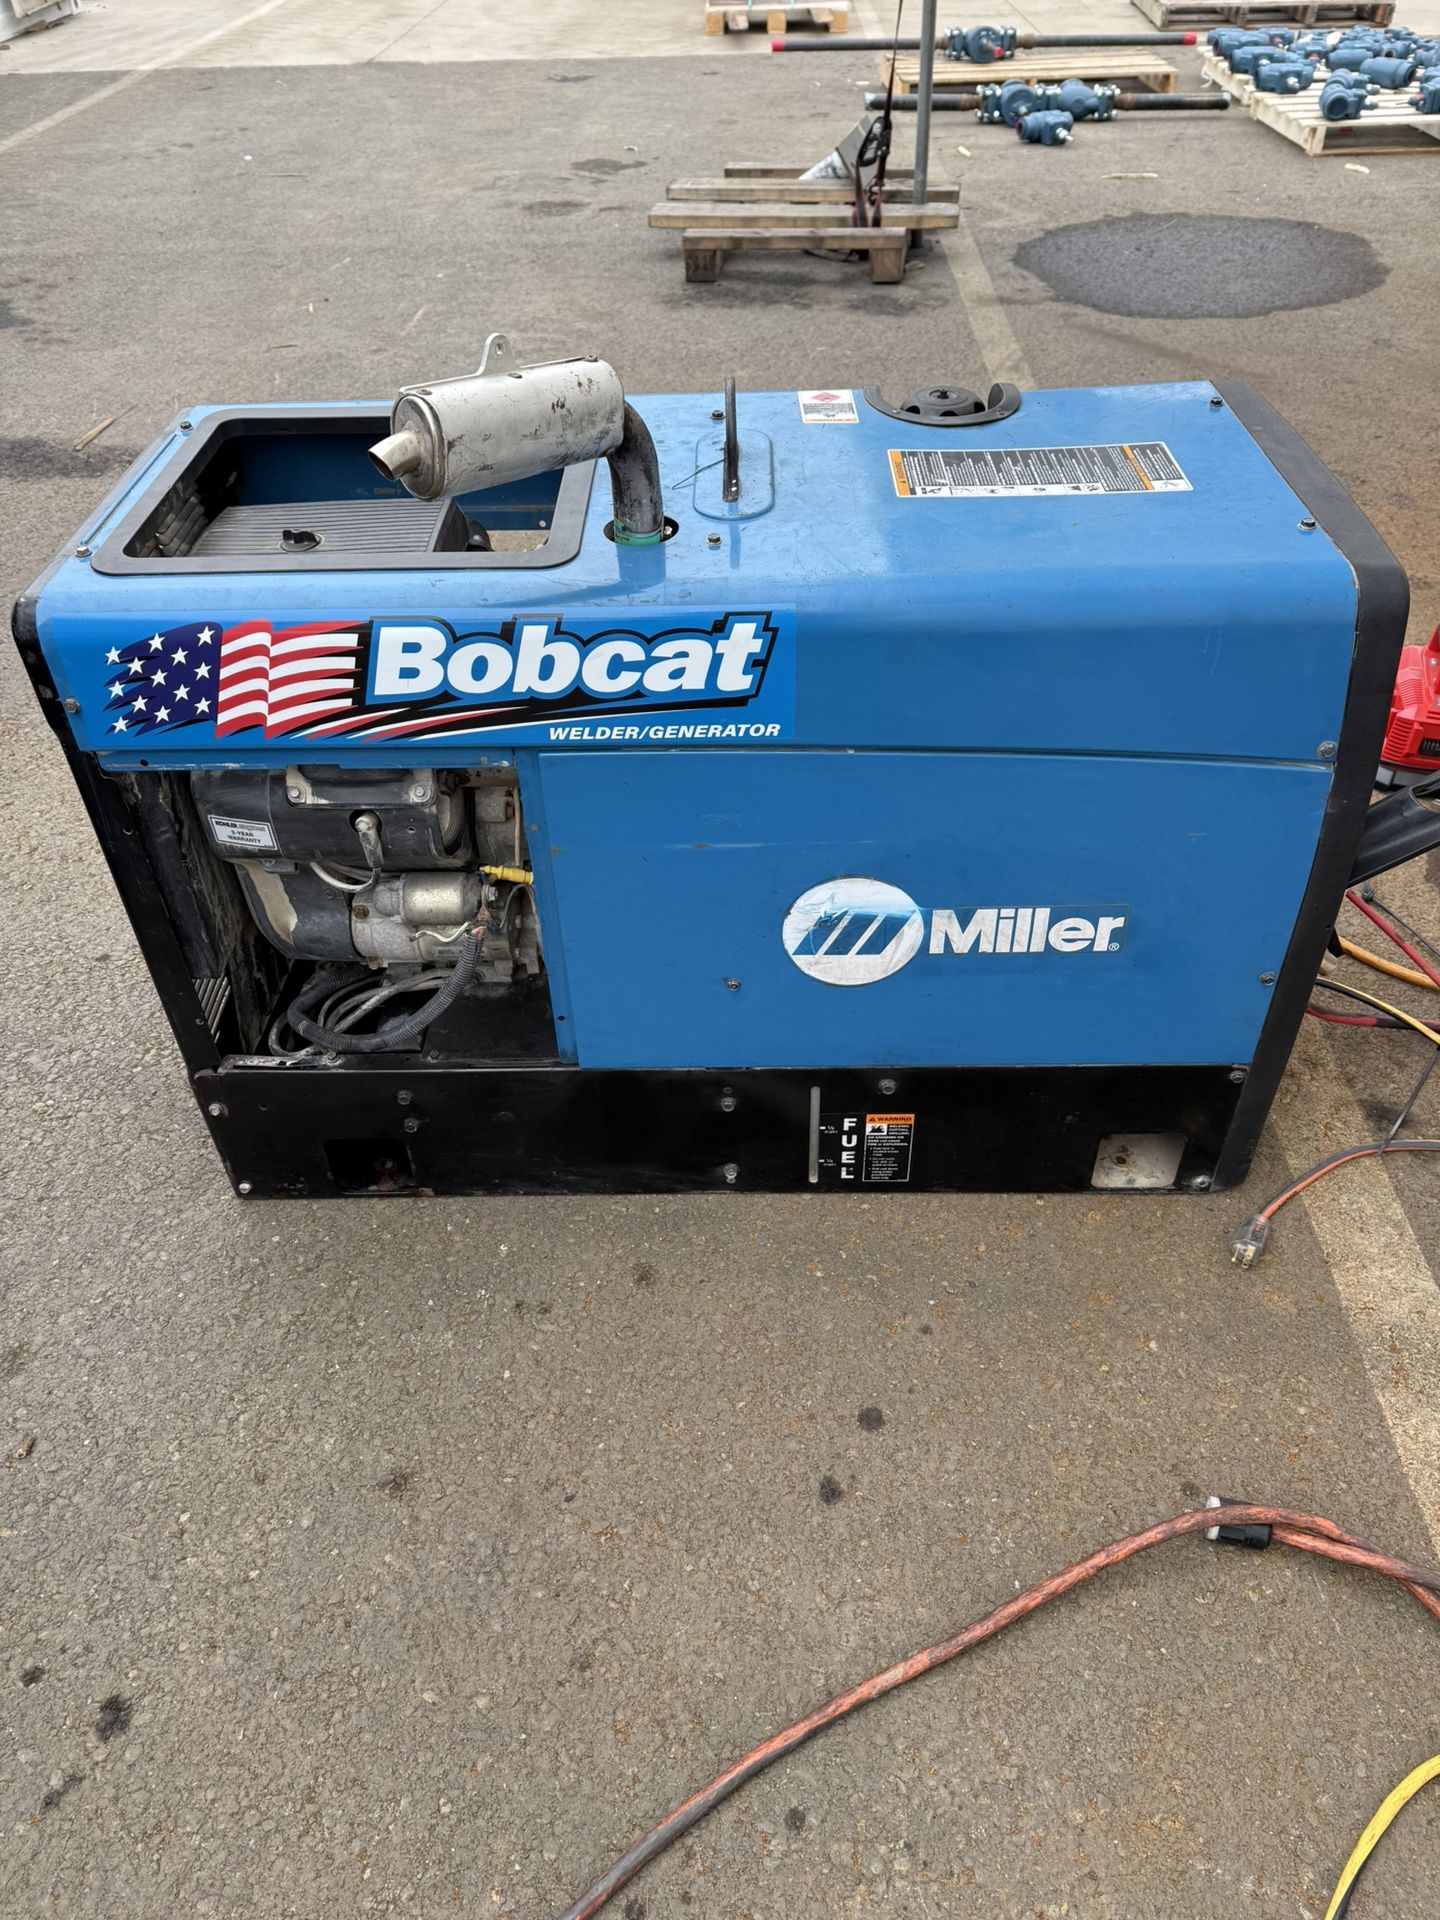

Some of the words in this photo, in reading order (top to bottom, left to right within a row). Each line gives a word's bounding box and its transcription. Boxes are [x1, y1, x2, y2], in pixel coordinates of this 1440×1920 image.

[374, 622, 763, 696] Bobcat
[549, 723, 780, 741] WELDER/GENERATOR
[929, 907, 1126, 955] Miller
[841, 1117, 857, 1179] FUEL
